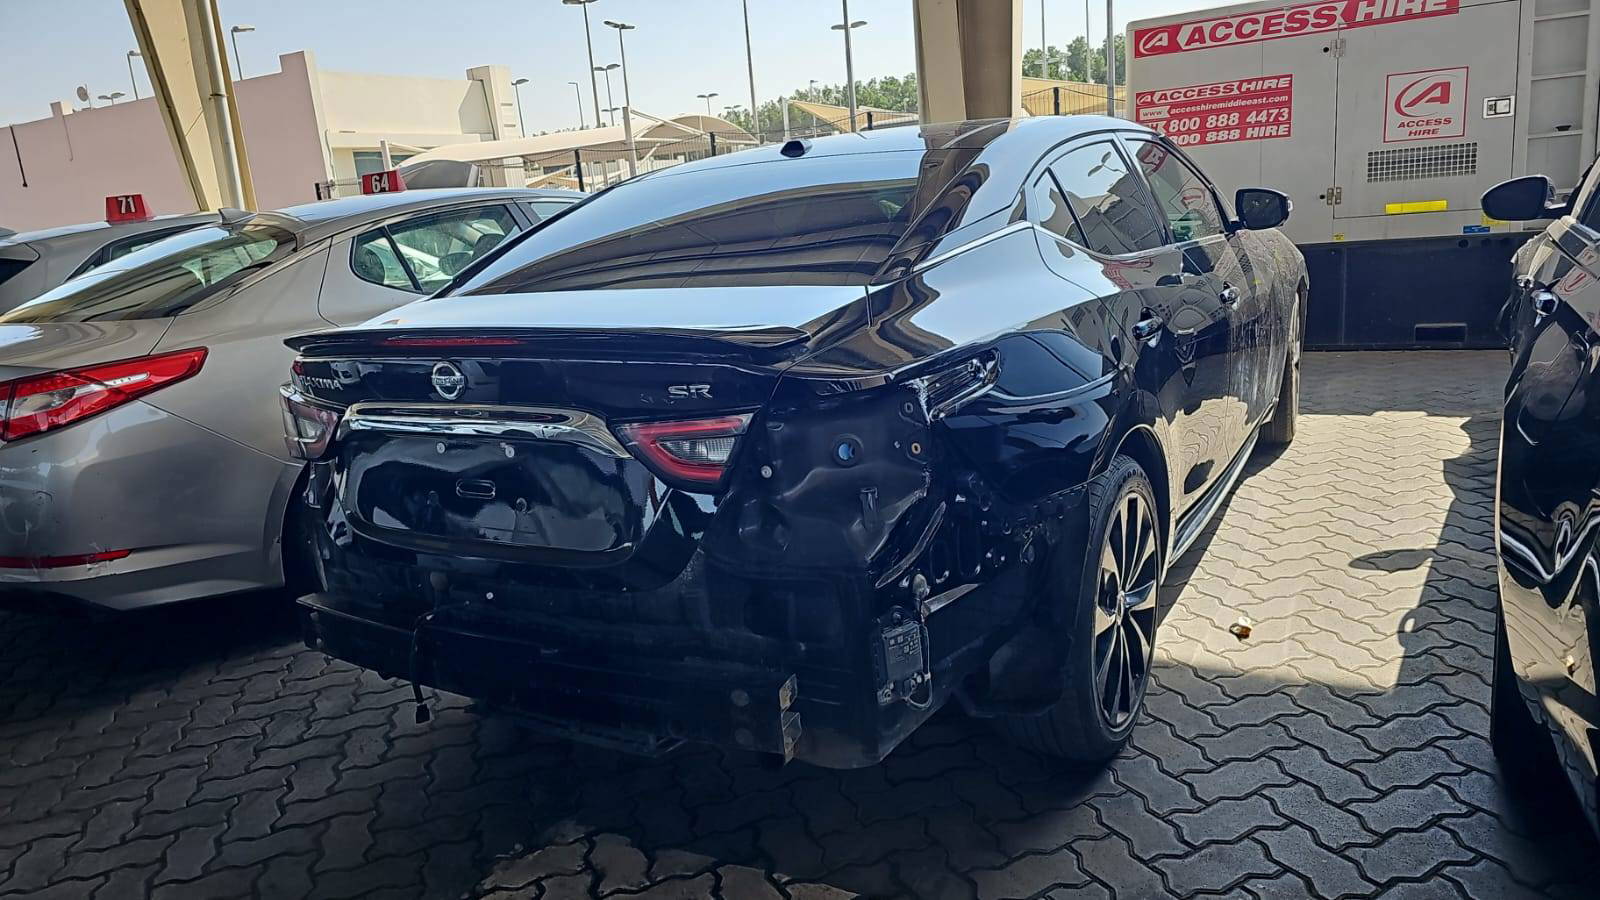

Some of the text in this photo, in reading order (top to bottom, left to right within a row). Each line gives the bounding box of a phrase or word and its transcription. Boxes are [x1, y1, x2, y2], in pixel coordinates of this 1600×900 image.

[1184, 6, 1339, 47] ACCESS
[1157, 83, 1235, 102] ACCESS
[1241, 77, 1290, 92] HIRE
[1170, 95, 1288, 114] accesshiremiddleeast.com
[1169, 107, 1290, 132] 800 888 4473
[1397, 117, 1452, 129] ACCESS
[1206, 129, 1240, 142] 888
[1246, 124, 1290, 138] HIRE
[1408, 128, 1440, 137] HIRE
[371, 173, 389, 193] 64
[117, 196, 136, 214] 71
[668, 384, 712, 399] SR
